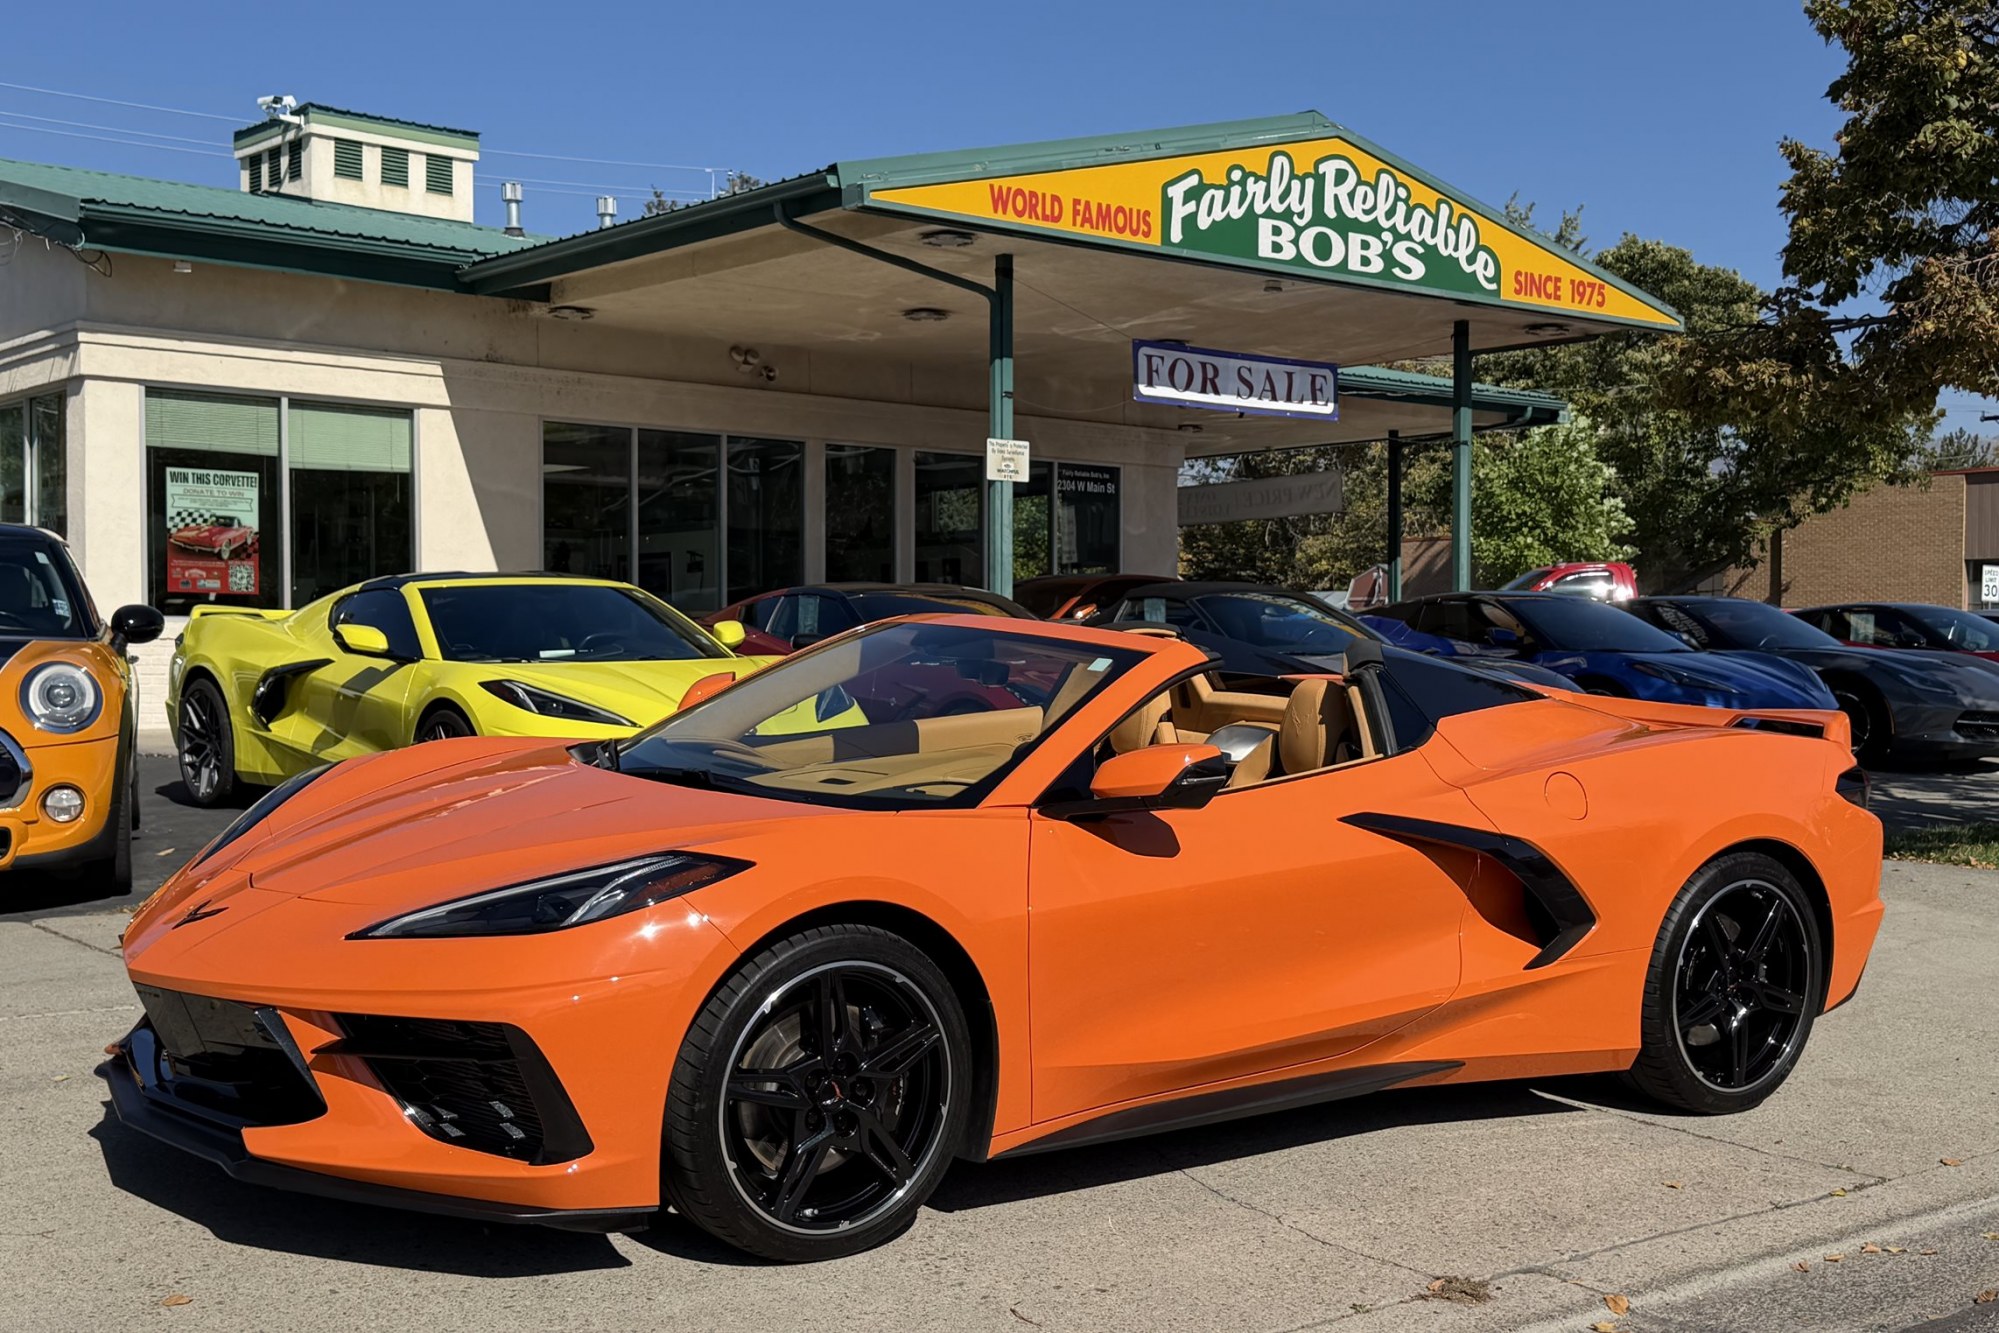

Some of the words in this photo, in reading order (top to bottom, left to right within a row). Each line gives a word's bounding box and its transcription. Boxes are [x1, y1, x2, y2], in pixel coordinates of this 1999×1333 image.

[989, 183, 1063, 223] WORLD
[1072, 197, 1152, 239] FAMOUS
[1167, 155, 1314, 243] Fairly
[1318, 159, 1497, 291] Reliable
[1258, 217, 1426, 282] BOB'S
[1513, 270, 1561, 301] SINCE
[1569, 278, 1606, 308] 1975
[1144, 353, 1221, 396] FOR
[1236, 365, 1329, 406] SALE
[169, 470, 190, 483] WIN
[191, 471, 211, 485] THIS
[212, 473, 258, 488] CORVETTE!
[183, 488, 214, 496] DONATE
[1057, 479, 1075, 491] 2304
[1076, 480, 1086, 492] W
[1086, 481, 1105, 494] Main
[1106, 482, 1116, 494] St
[1984, 584, 1997, 597] 30
